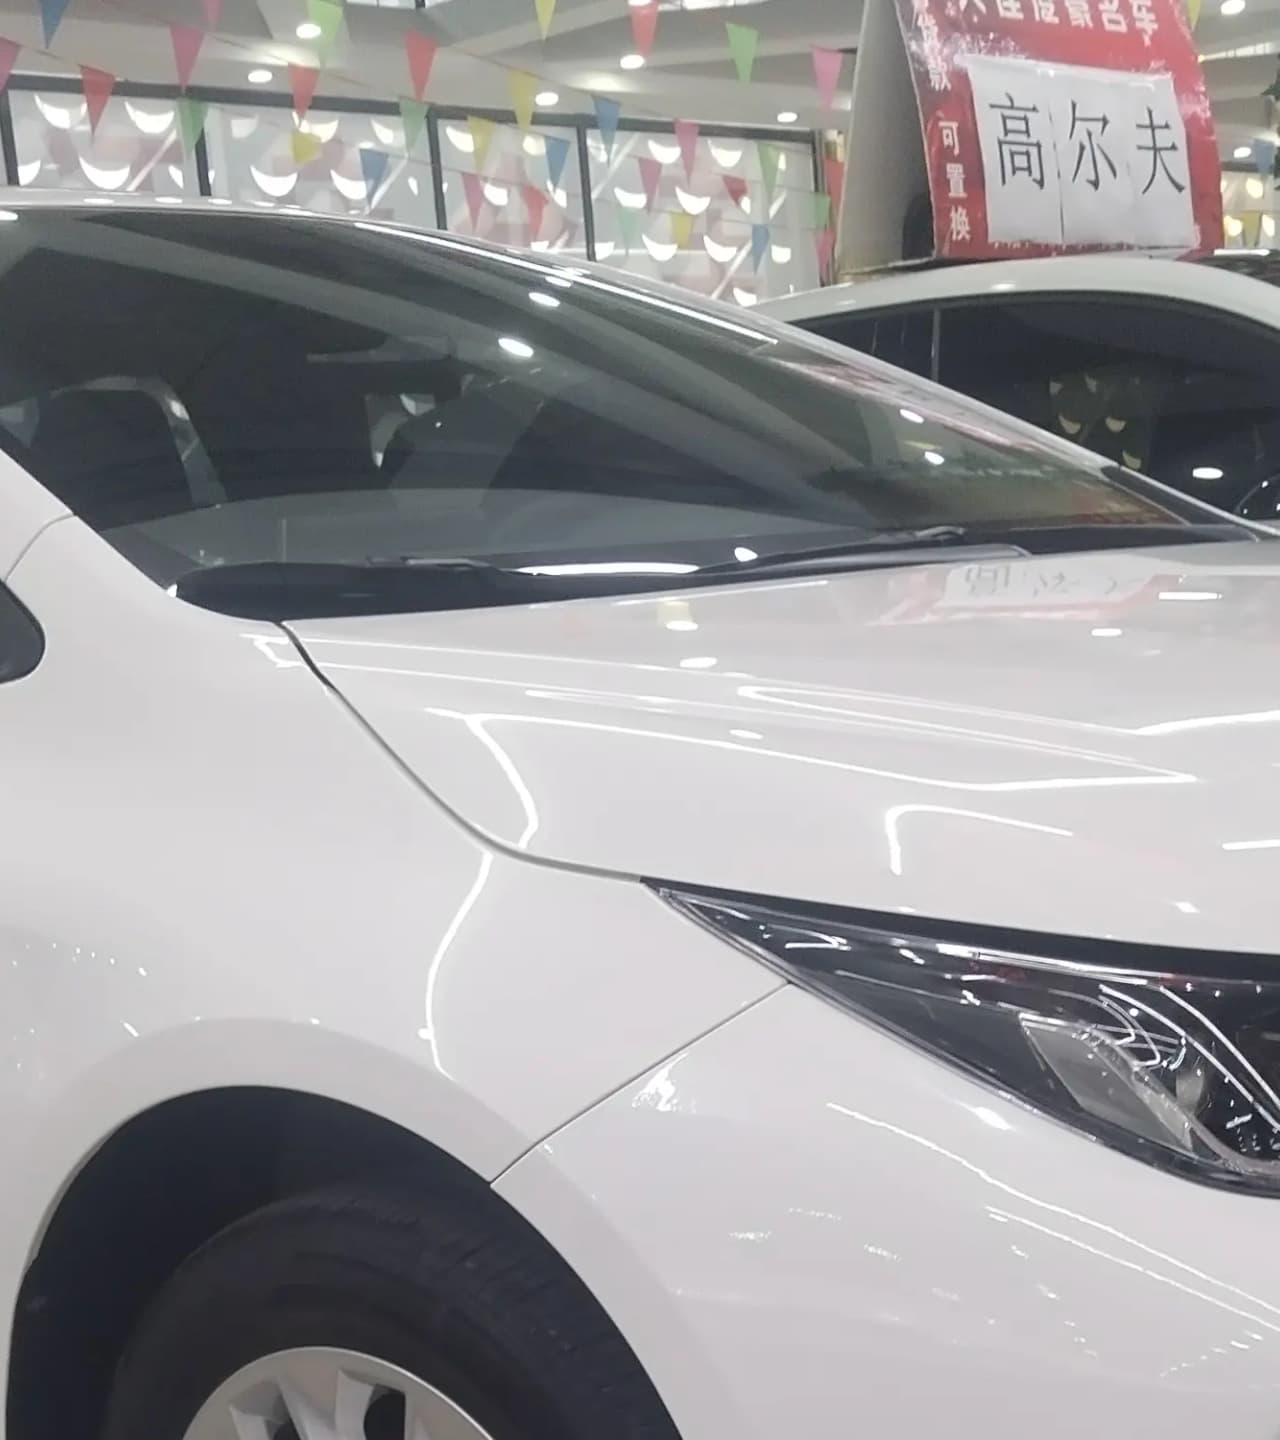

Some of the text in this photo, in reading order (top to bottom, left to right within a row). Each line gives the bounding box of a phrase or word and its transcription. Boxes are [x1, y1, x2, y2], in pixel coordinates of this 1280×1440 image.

[938, 120, 971, 242] 可置换
[988, 92, 1186, 195] 高尔夫
